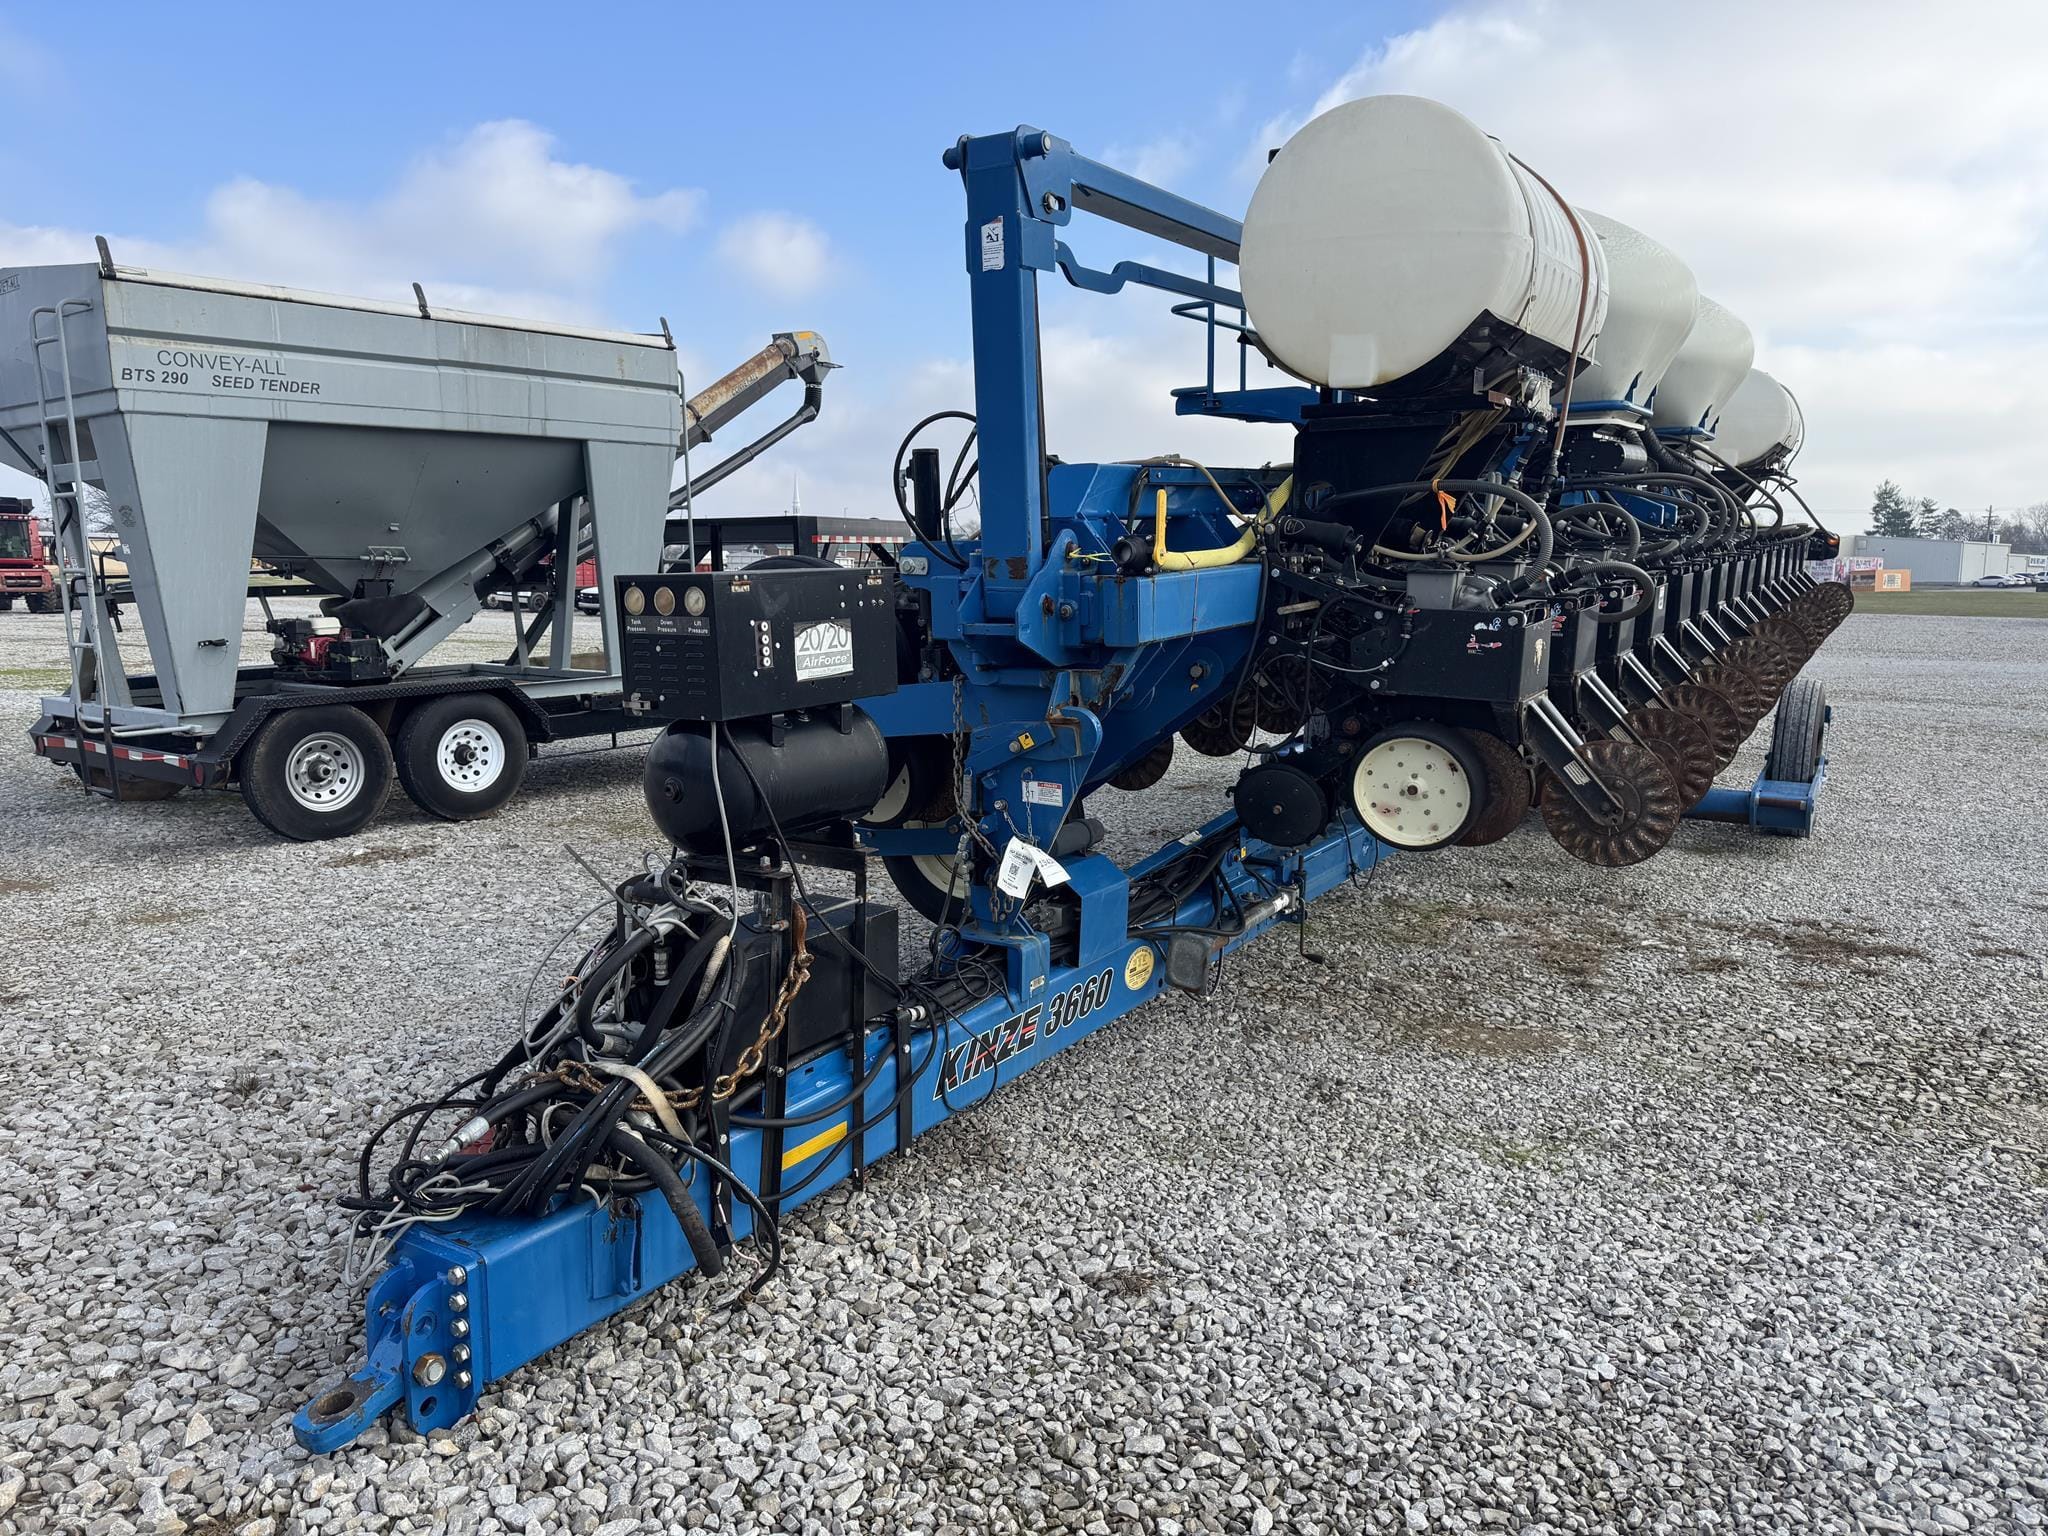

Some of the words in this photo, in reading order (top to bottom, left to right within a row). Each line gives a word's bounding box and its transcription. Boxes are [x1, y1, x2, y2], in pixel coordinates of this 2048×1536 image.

[157, 350, 287, 376] CONVEY-ALL
[121, 367, 156, 383] BTS
[161, 370, 189, 385] 290
[211, 374, 255, 390] SEED
[259, 378, 321, 395] TENDER
[799, 624, 849, 651] 20/20
[802, 655, 848, 668] AirForce
[933, 1002, 1044, 1101] KINZE
[1044, 967, 1115, 1038] 3660
